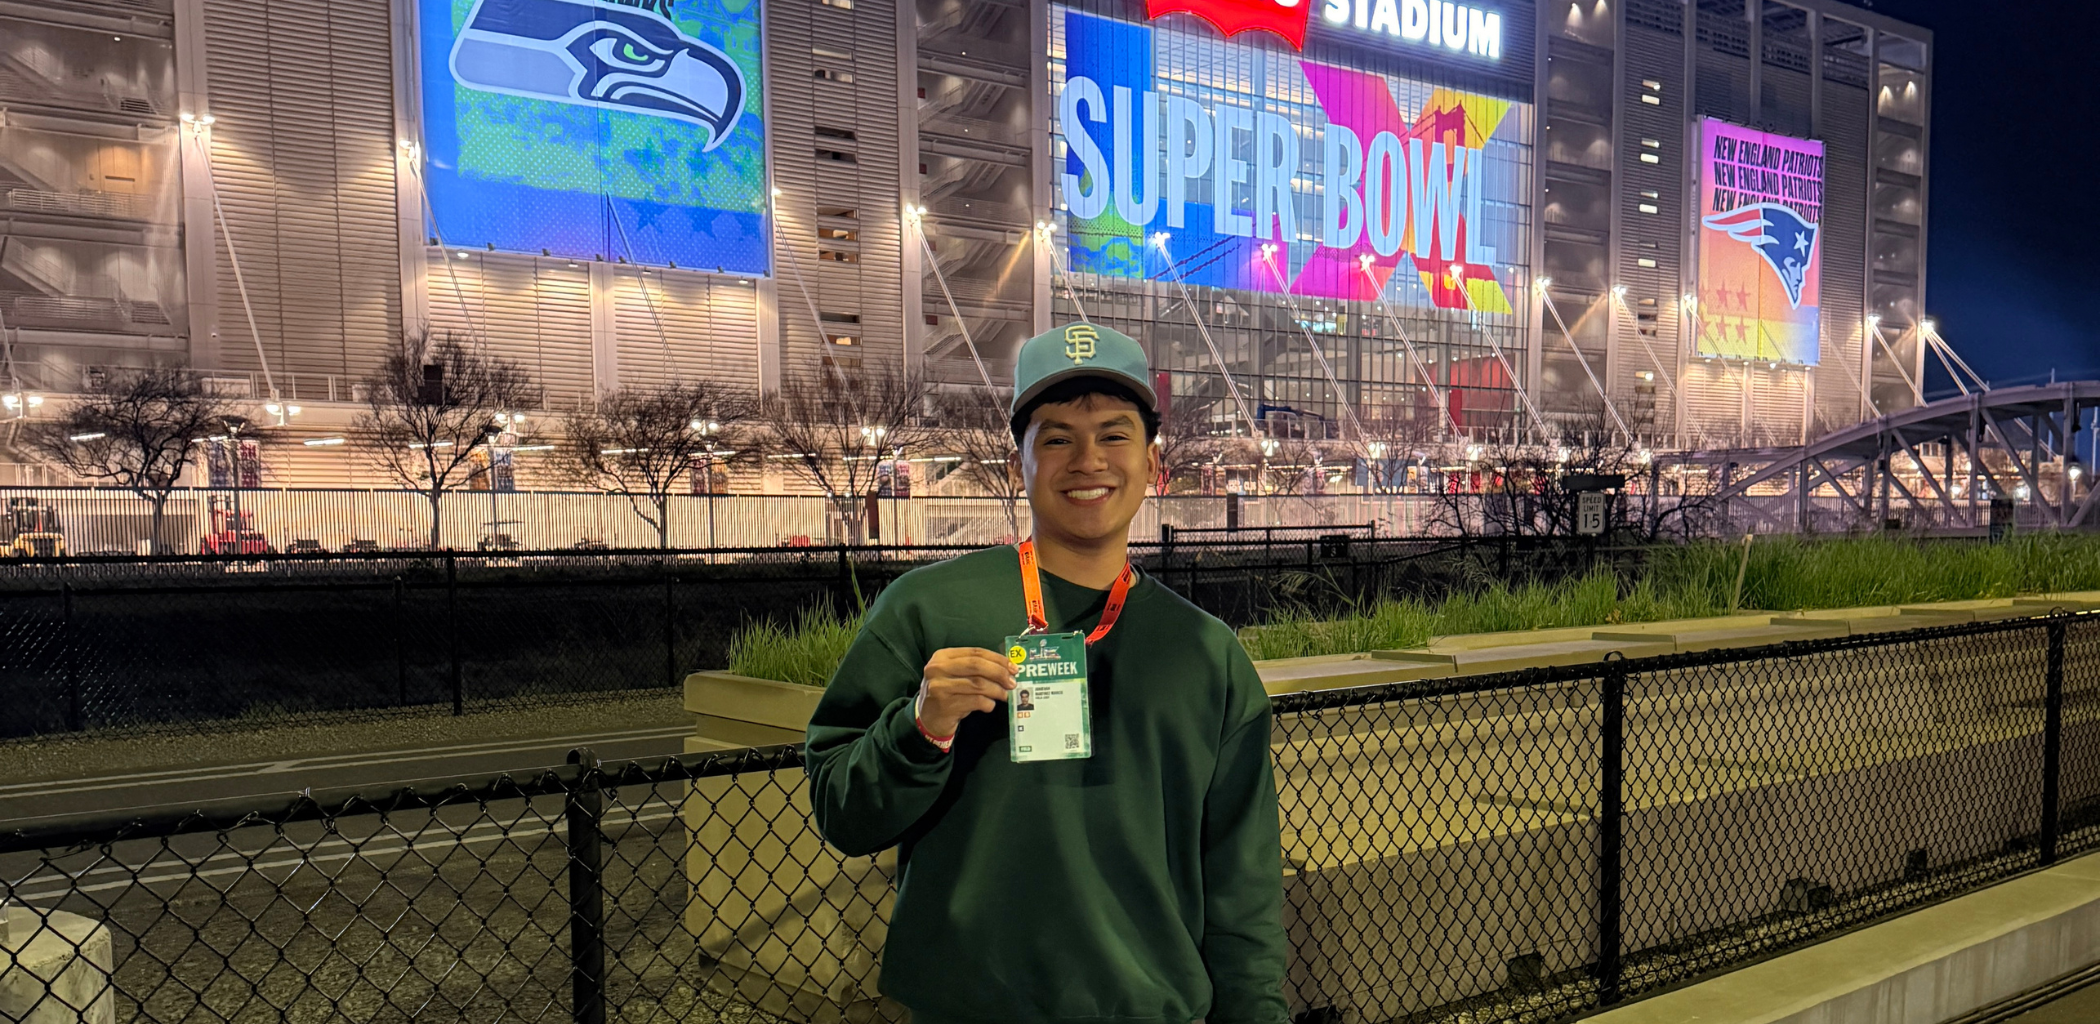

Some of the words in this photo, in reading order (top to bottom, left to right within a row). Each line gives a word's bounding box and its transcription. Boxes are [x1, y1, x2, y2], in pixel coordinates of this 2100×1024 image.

[1325, 0, 1500, 59] STADIUM
[1059, 75, 1299, 243] SUPER
[1323, 122, 1496, 265] BOWL
[1713, 135, 1737, 162] NEW
[1738, 140, 1781, 171] ENGLAND
[1781, 149, 1824, 179] PATRIOTS
[1713, 161, 1736, 188] NEW
[1738, 166, 1780, 196] ENGLAND
[1781, 174, 1823, 204] PATRIOTS
[1712, 187, 1737, 212] NEW
[1065, 325, 1100, 365] SF
[1582, 496, 1602, 504] SPEED
[1584, 513, 1600, 528] 15
[1010, 649, 1022, 658] EX
[1015, 661, 1078, 678] PREWEEK
